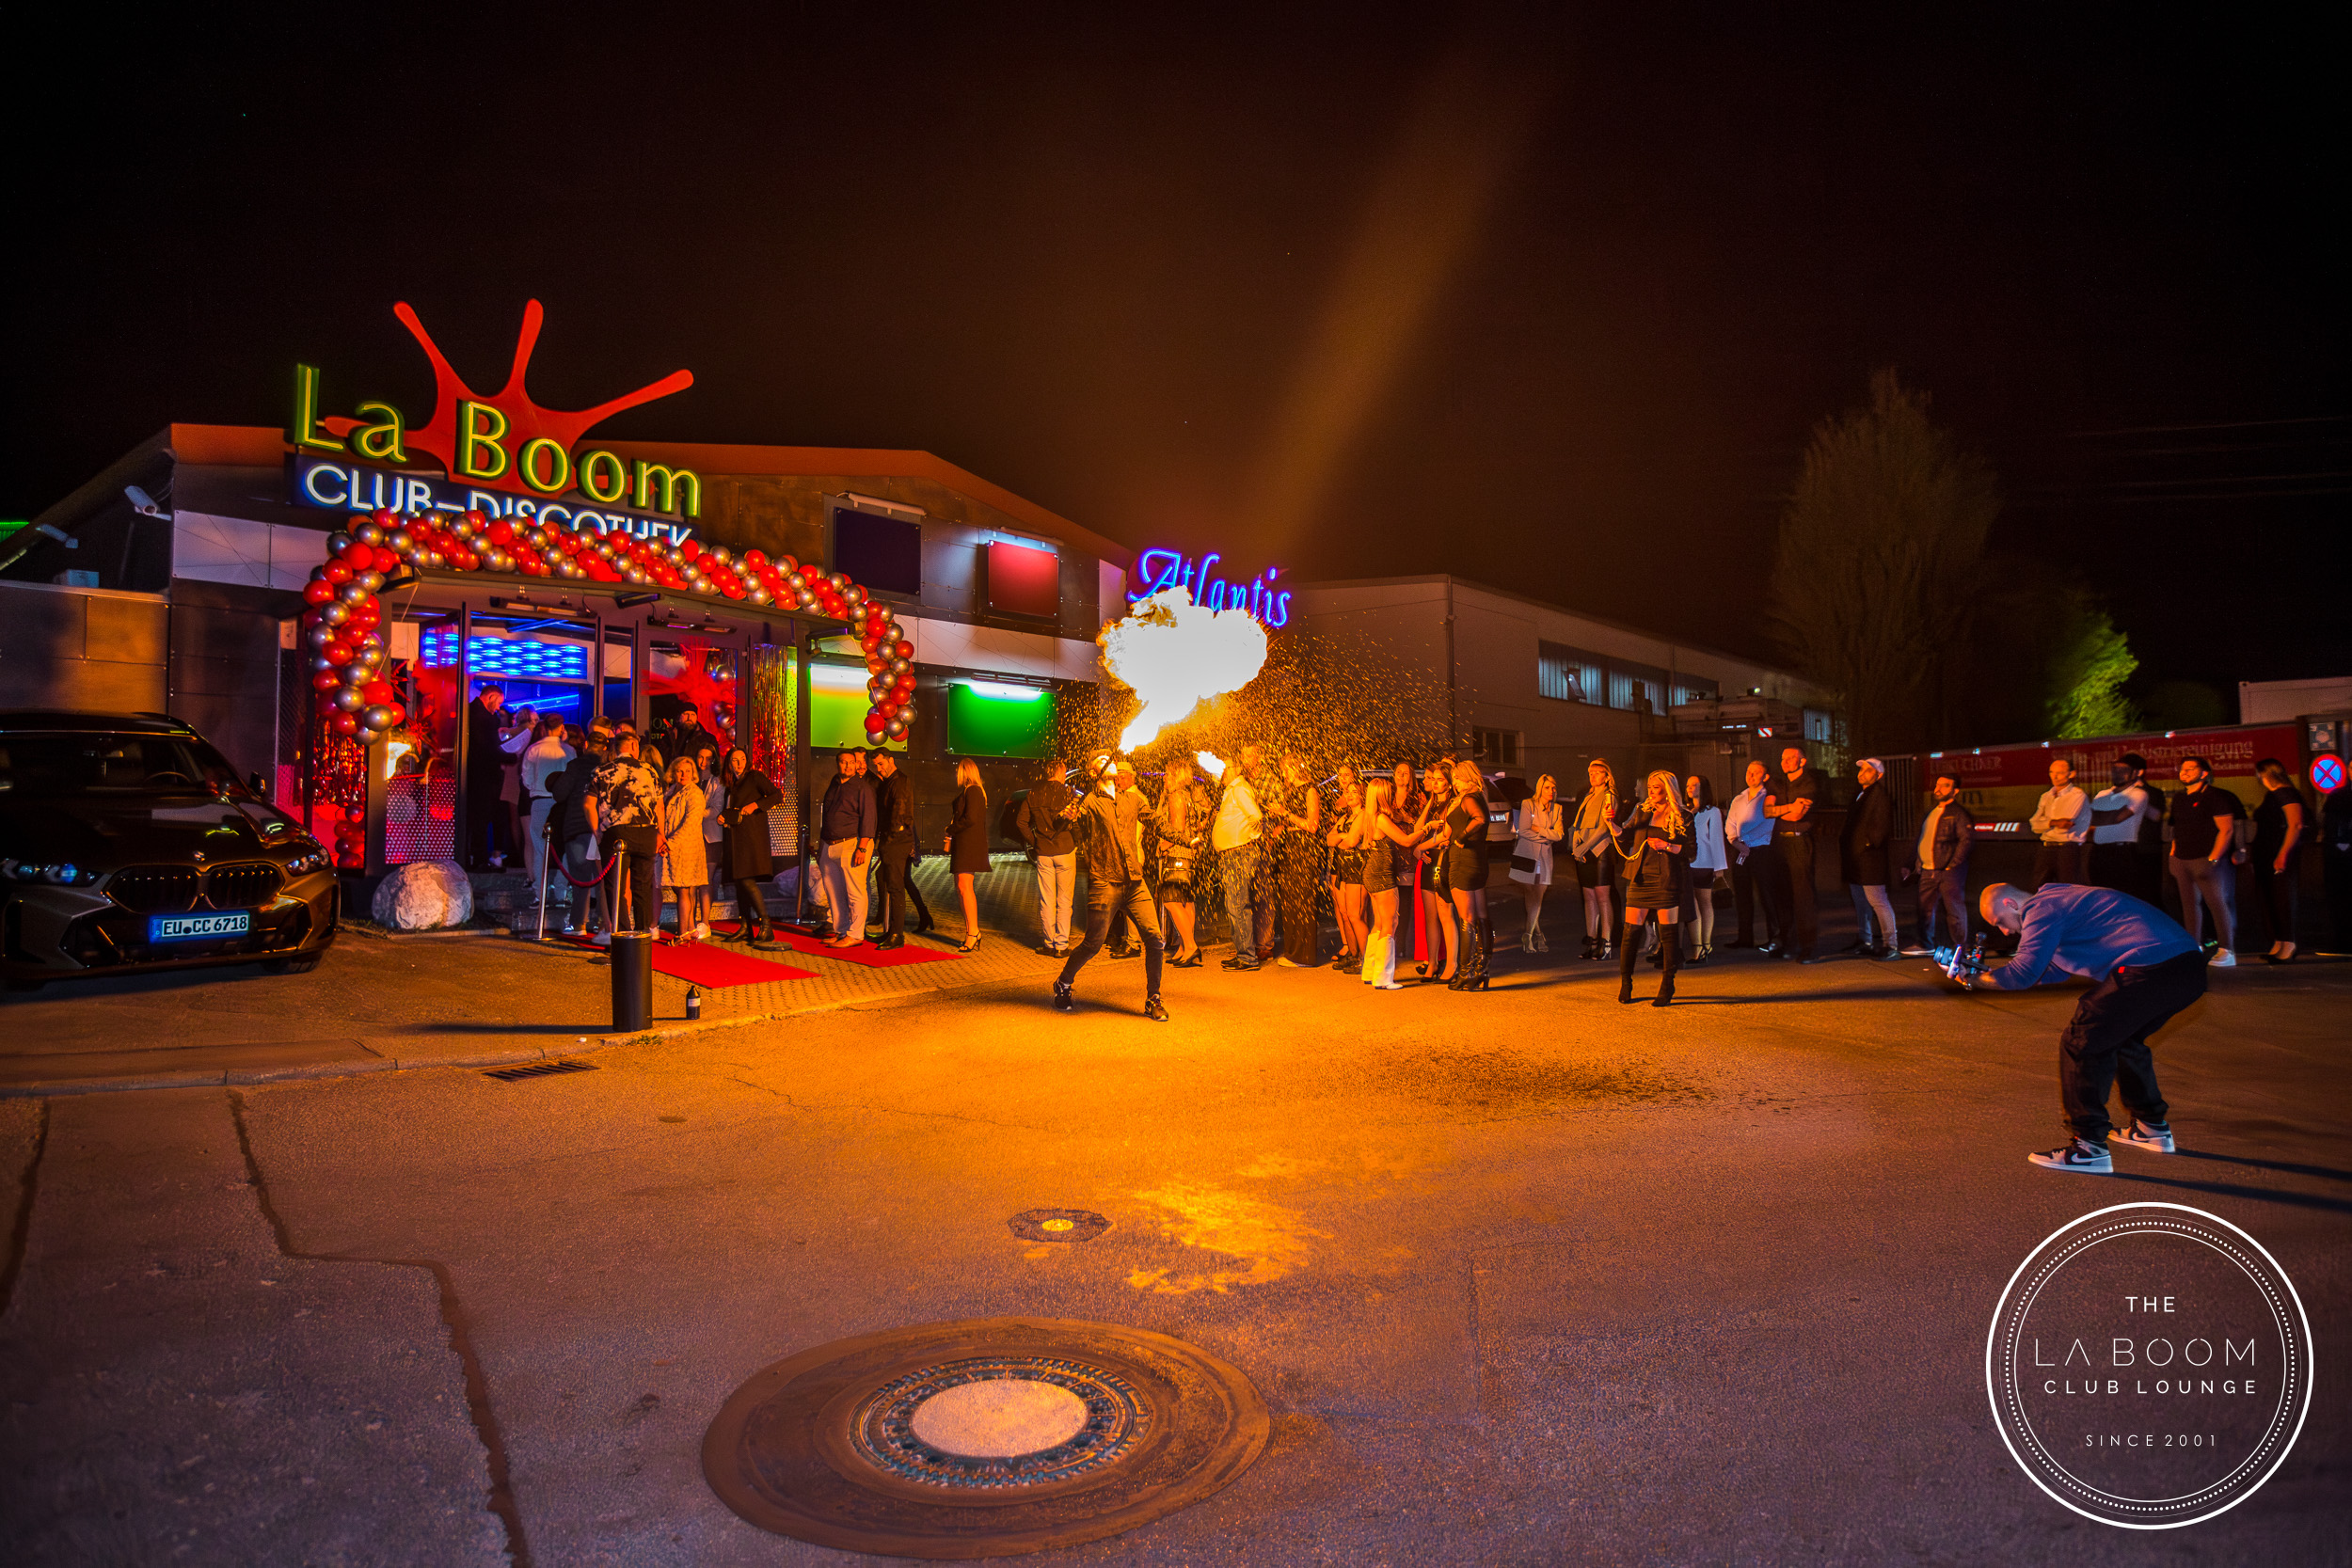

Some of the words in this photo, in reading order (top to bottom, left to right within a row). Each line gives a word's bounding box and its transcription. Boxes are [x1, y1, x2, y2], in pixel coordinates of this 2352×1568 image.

[295, 363, 407, 462] La
[455, 399, 702, 518] Boom
[1127, 547, 1292, 628] Atlantis
[163, 921, 183, 935] EU
[193, 919, 211, 933] CC
[214, 916, 247, 931] 6718
